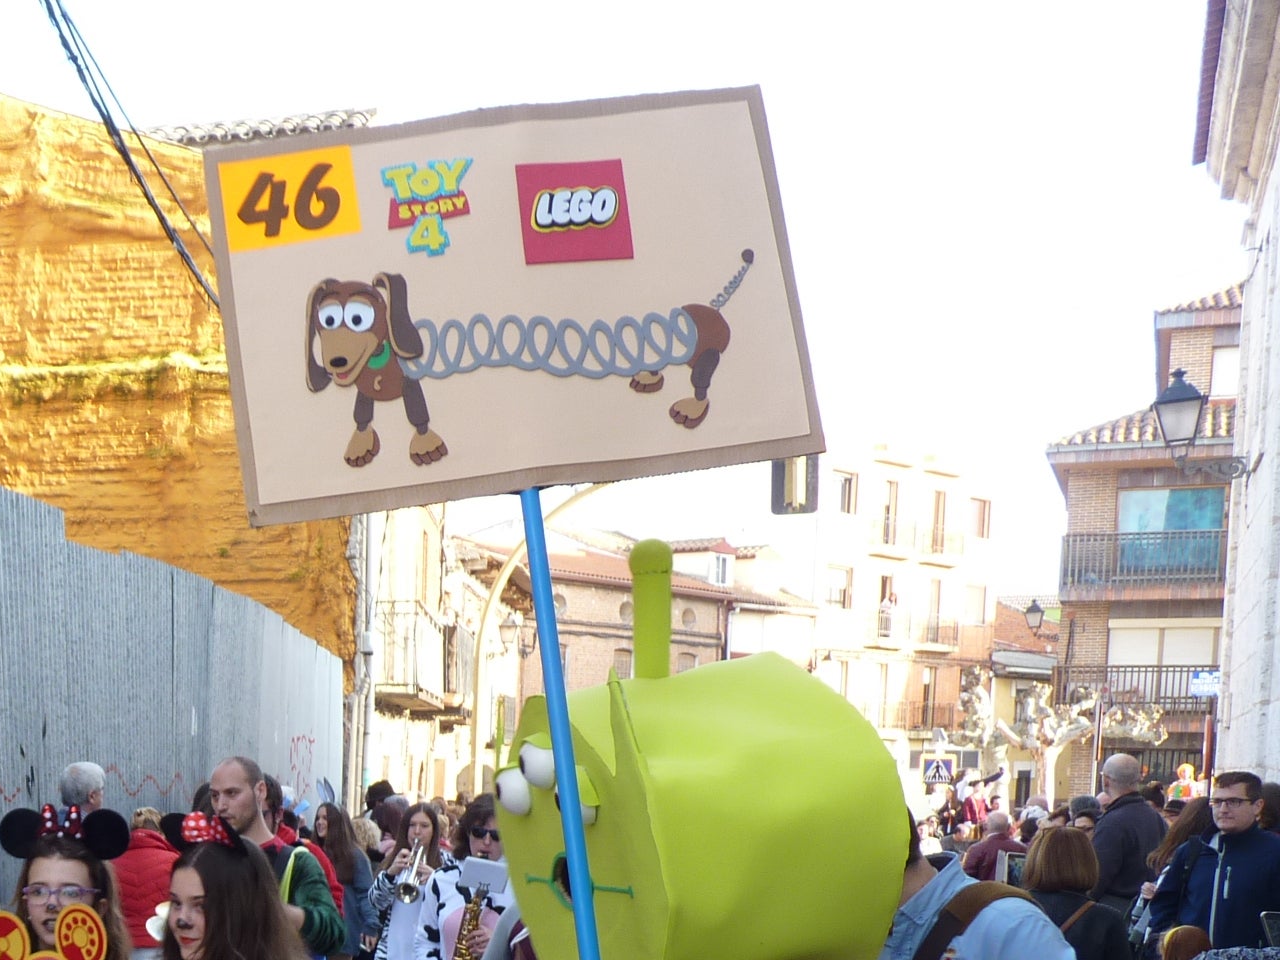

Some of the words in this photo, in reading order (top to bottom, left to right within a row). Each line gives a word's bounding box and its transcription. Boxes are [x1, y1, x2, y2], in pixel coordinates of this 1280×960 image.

[237, 162, 341, 237] 46
[383, 159, 469, 201] TOY
[399, 196, 466, 219] STORY
[535, 183, 616, 226] LEGO
[408, 216, 448, 253] 4
